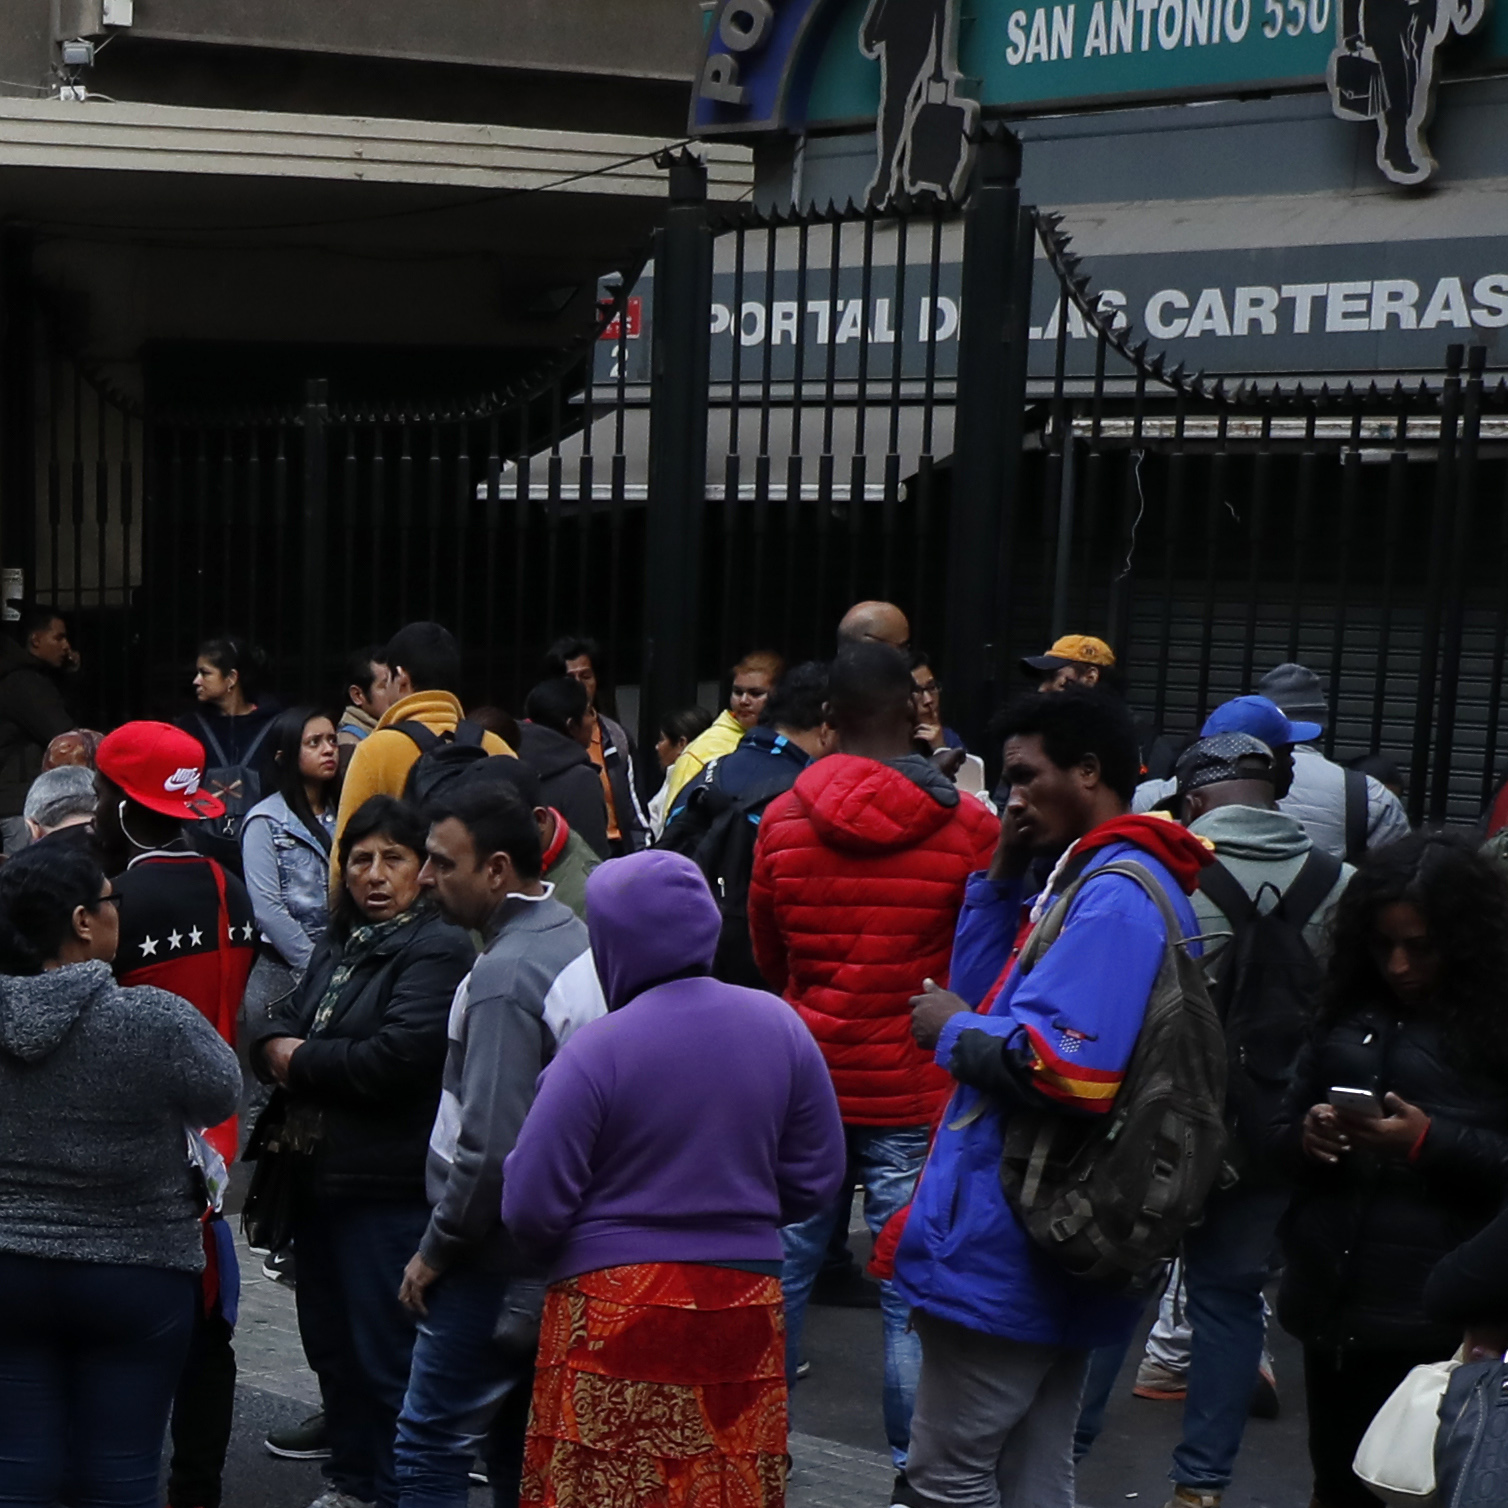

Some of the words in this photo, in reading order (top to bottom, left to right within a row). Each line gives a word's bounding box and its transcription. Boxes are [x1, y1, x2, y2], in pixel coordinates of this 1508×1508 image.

[1006, 4, 1075, 66] SAN
[1084, 0, 1251, 57] ANTONIO
[1262, 0, 1330, 39] 550
[710, 299, 903, 347] PORTAL
[1144, 274, 1508, 340] CARTERAS
